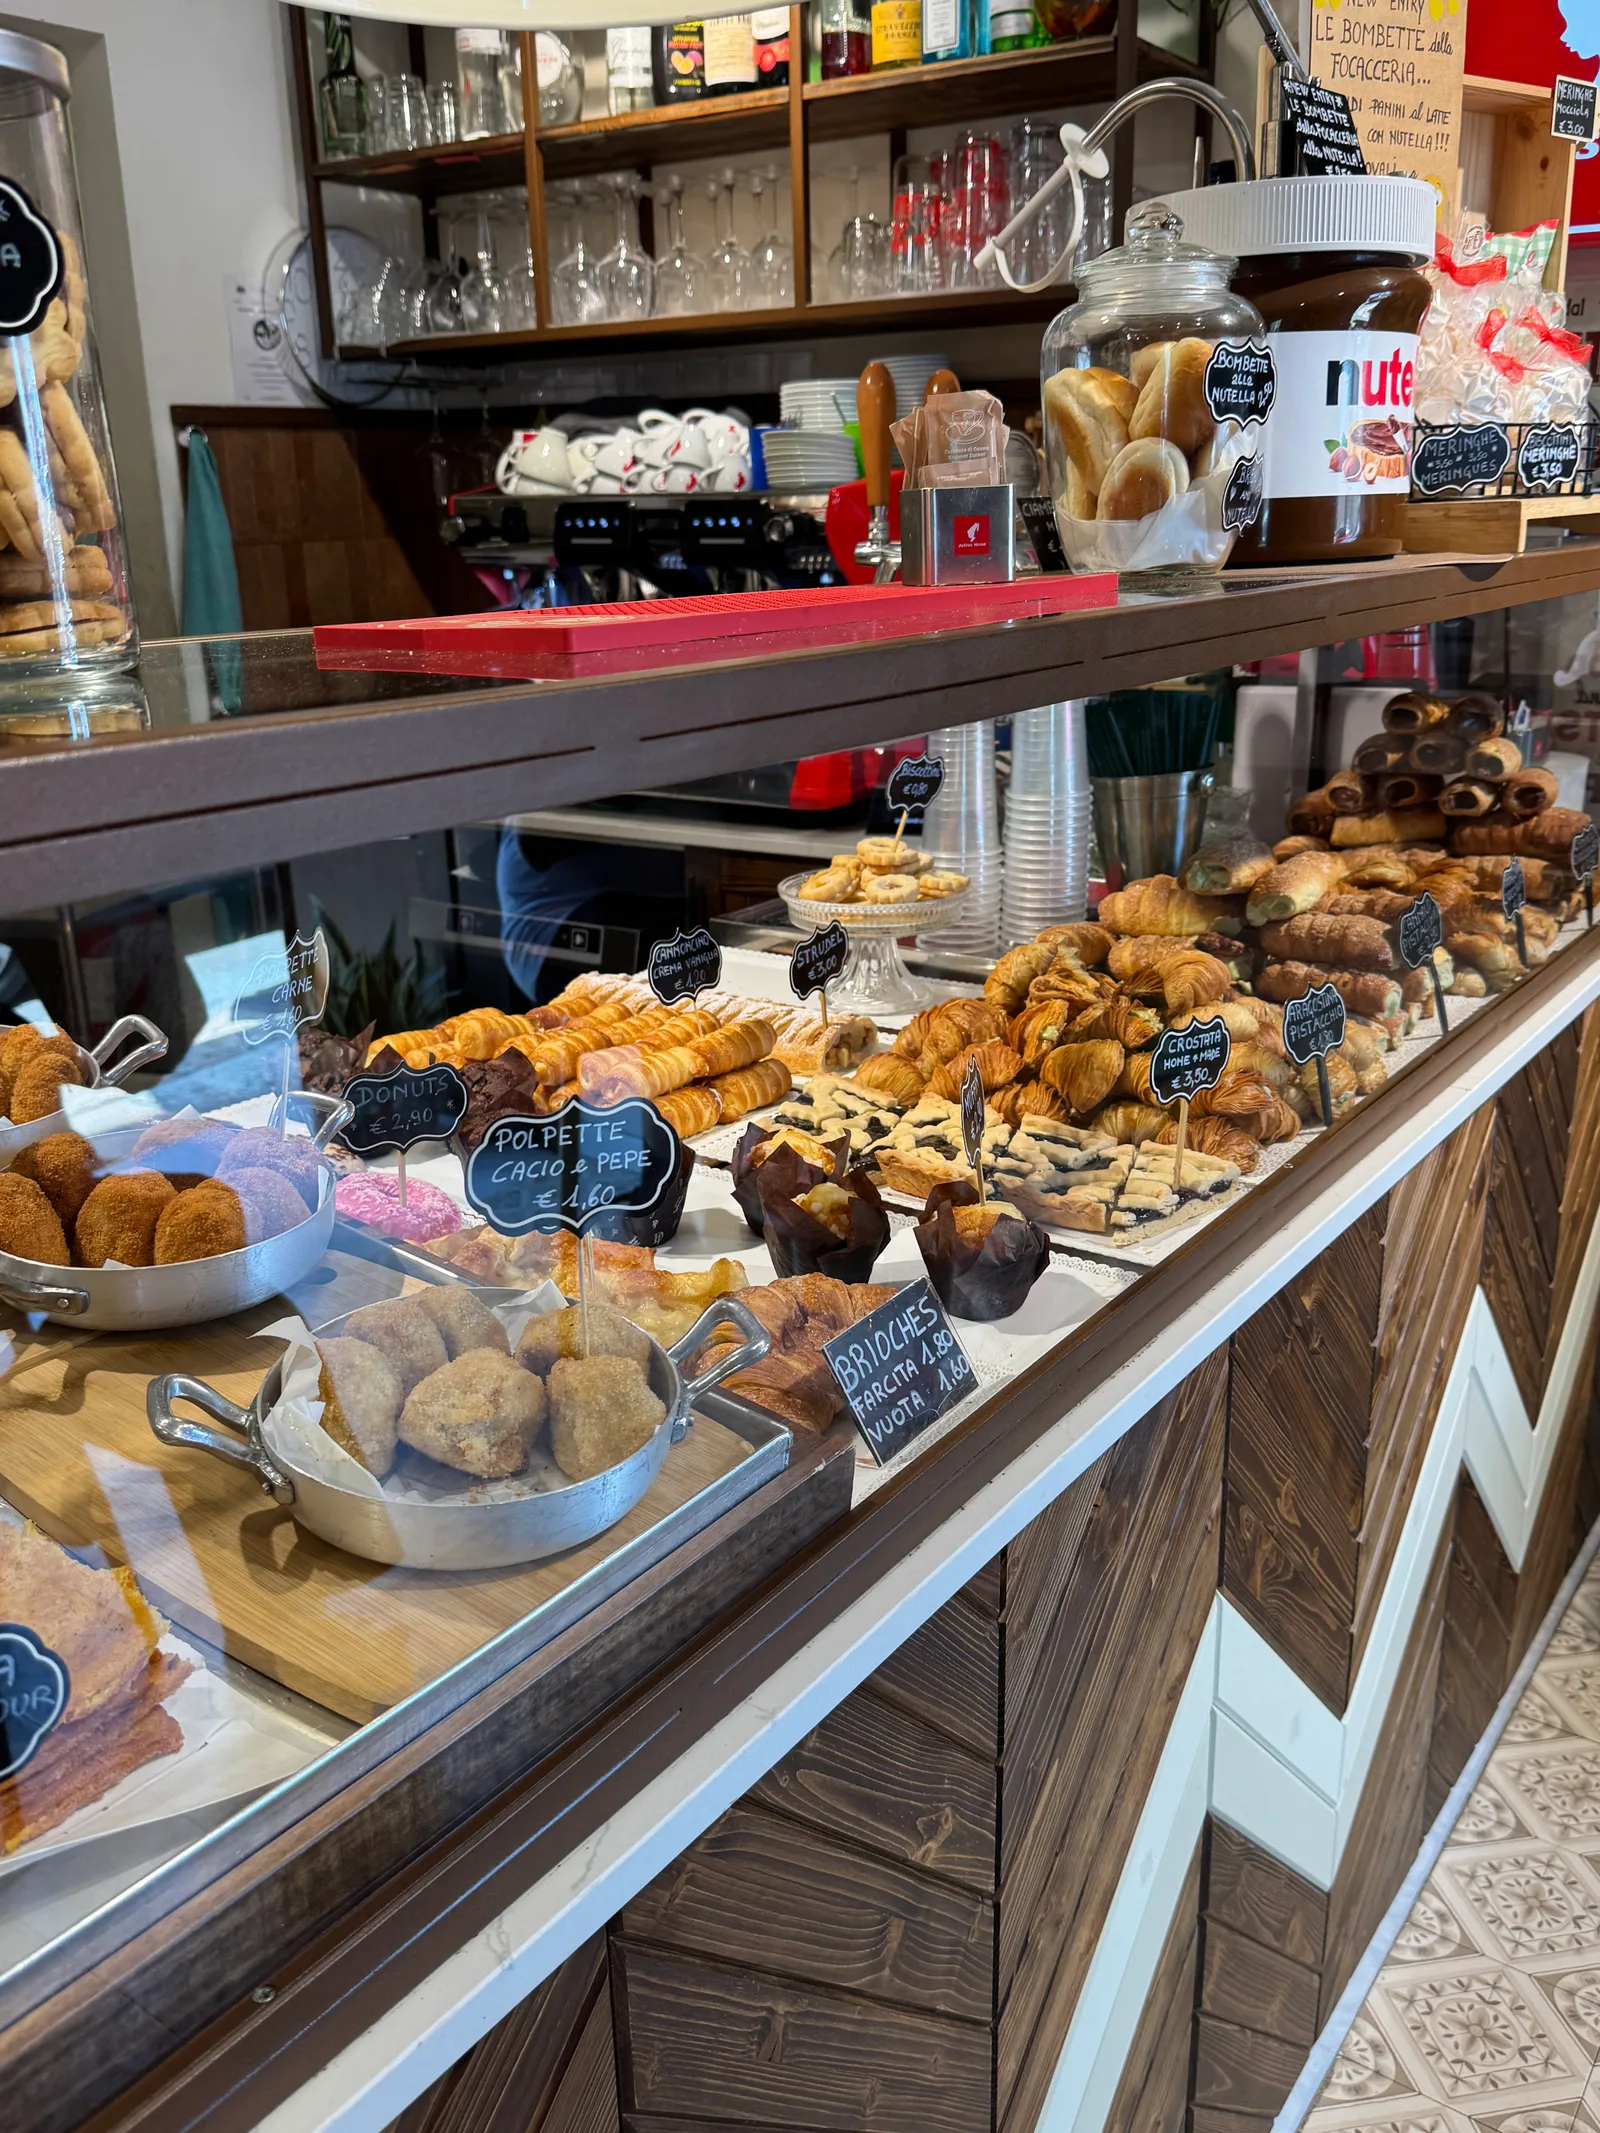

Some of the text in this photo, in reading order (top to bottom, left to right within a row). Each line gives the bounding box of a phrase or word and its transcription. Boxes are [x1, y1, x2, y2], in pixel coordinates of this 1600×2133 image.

[1390, 0, 1425, 25] ENTRY
[1315, 14, 1454, 55] LE BOMBETTE della
[1289, 98, 1350, 127] LE BOMBETTE
[1369, 99, 1406, 118] PANINI
[1409, 101, 1423, 121] al
[1427, 107, 1451, 125] LATTE
[1303, 139, 1323, 158] alla
[1315, 123, 1360, 147] FOCACCERIA
[1367, 128, 1384, 145] CON
[1213, 350, 1269, 373] BOMBETTE
[1211, 387, 1255, 405] NUTELLA
[1424, 429, 1499, 458] MERINGHE
[1522, 444, 1577, 464] MERINGHE
[1420, 459, 1498, 486] MERINGUES
[656, 934, 710, 963] CANNONCINO
[797, 931, 843, 969] STRUDEL
[653, 962, 683, 980] CREMA
[272, 975, 313, 1004] CARNE
[1289, 989, 1338, 1022] ARAGOSTINA
[1289, 1004, 1343, 1042] PISTACCHIO
[1168, 1029, 1222, 1053] CROSTATA
[1163, 1047, 1221, 1070] HOME MADE
[355, 1073, 449, 1108] DONUTS
[495, 1120, 626, 1153] POLPETTE
[491, 1150, 652, 1183] CACIO e PEPE
[834, 1296, 938, 1394] BRIOCHES
[850, 1329, 954, 1420] FARCITA 1,80
[867, 1354, 970, 1443] VUOTA 1,60
